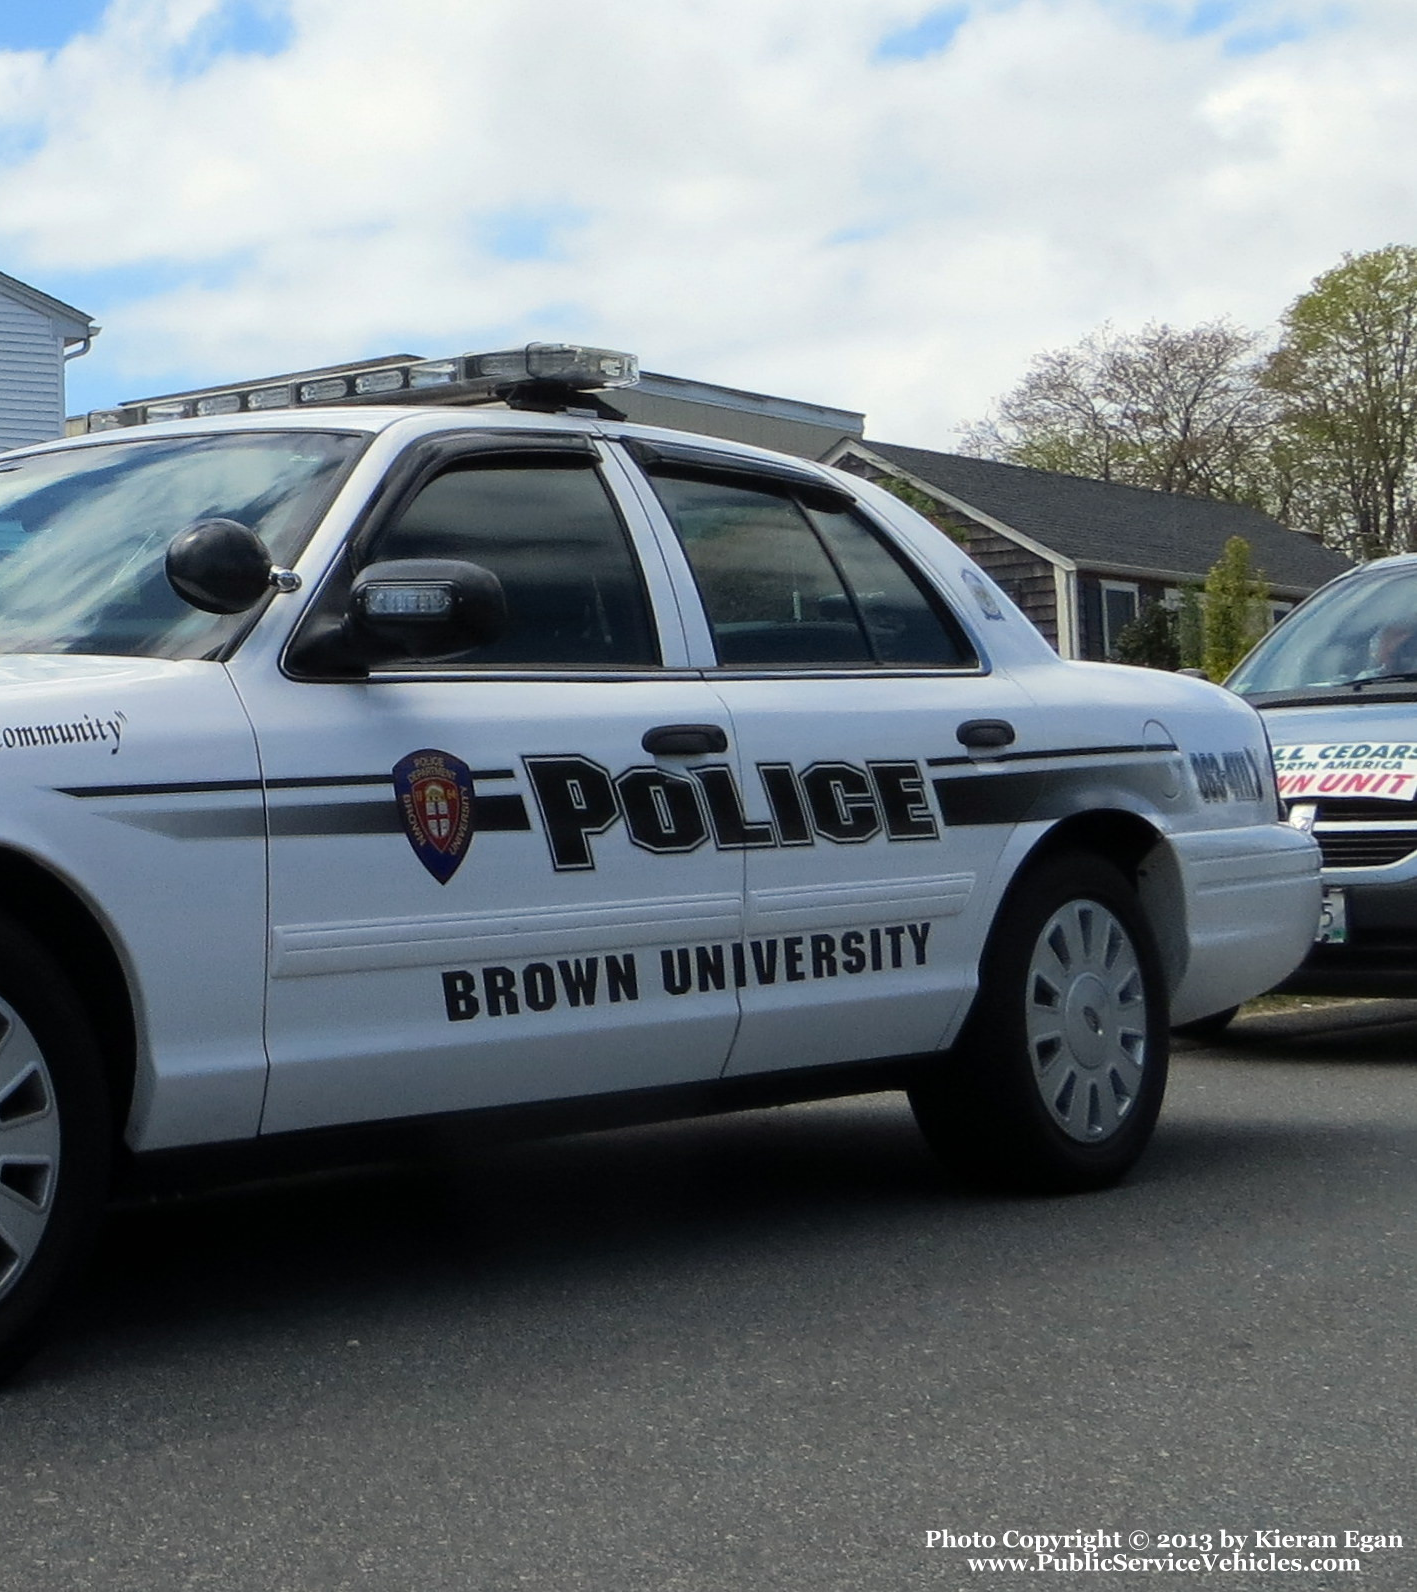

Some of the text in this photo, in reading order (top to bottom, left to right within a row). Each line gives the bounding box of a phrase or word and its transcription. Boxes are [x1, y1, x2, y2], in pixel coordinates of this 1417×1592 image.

[413, 756, 444, 768] POLICE
[1322, 760, 1403, 771] AMERICA
[1317, 773, 1415, 794] UNIT
[520, 753, 940, 872] POLICE
[441, 922, 931, 1022] BROWN UNIVERSITY
